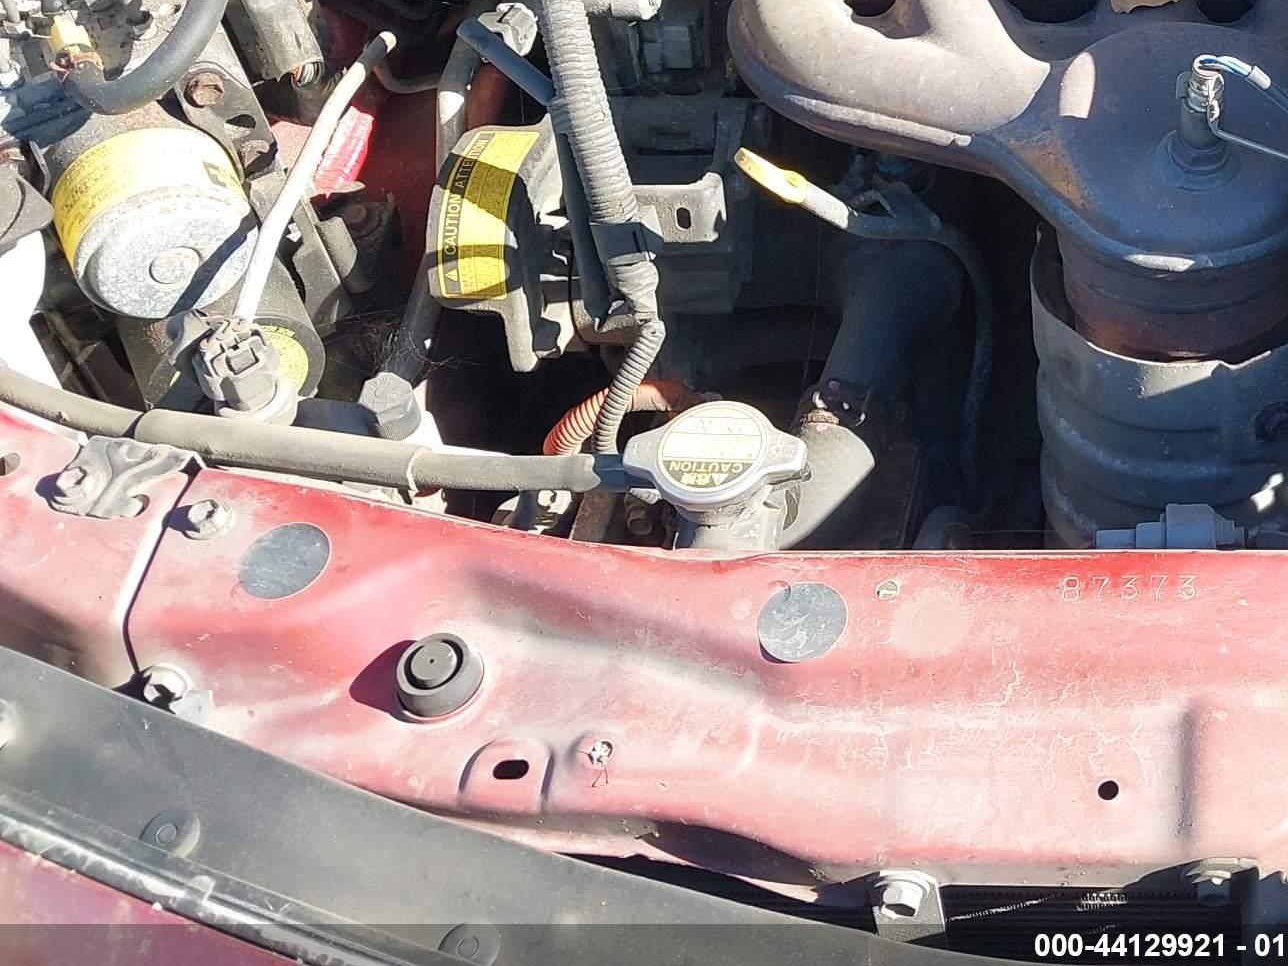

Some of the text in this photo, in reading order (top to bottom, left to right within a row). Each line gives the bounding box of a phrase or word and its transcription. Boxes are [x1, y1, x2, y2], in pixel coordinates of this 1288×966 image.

[455, 138, 490, 189] ATTENTION
[444, 194, 462, 255] CAUTION
[669, 461, 744, 474] CAUTION
[1062, 574, 1198, 603] 87373
